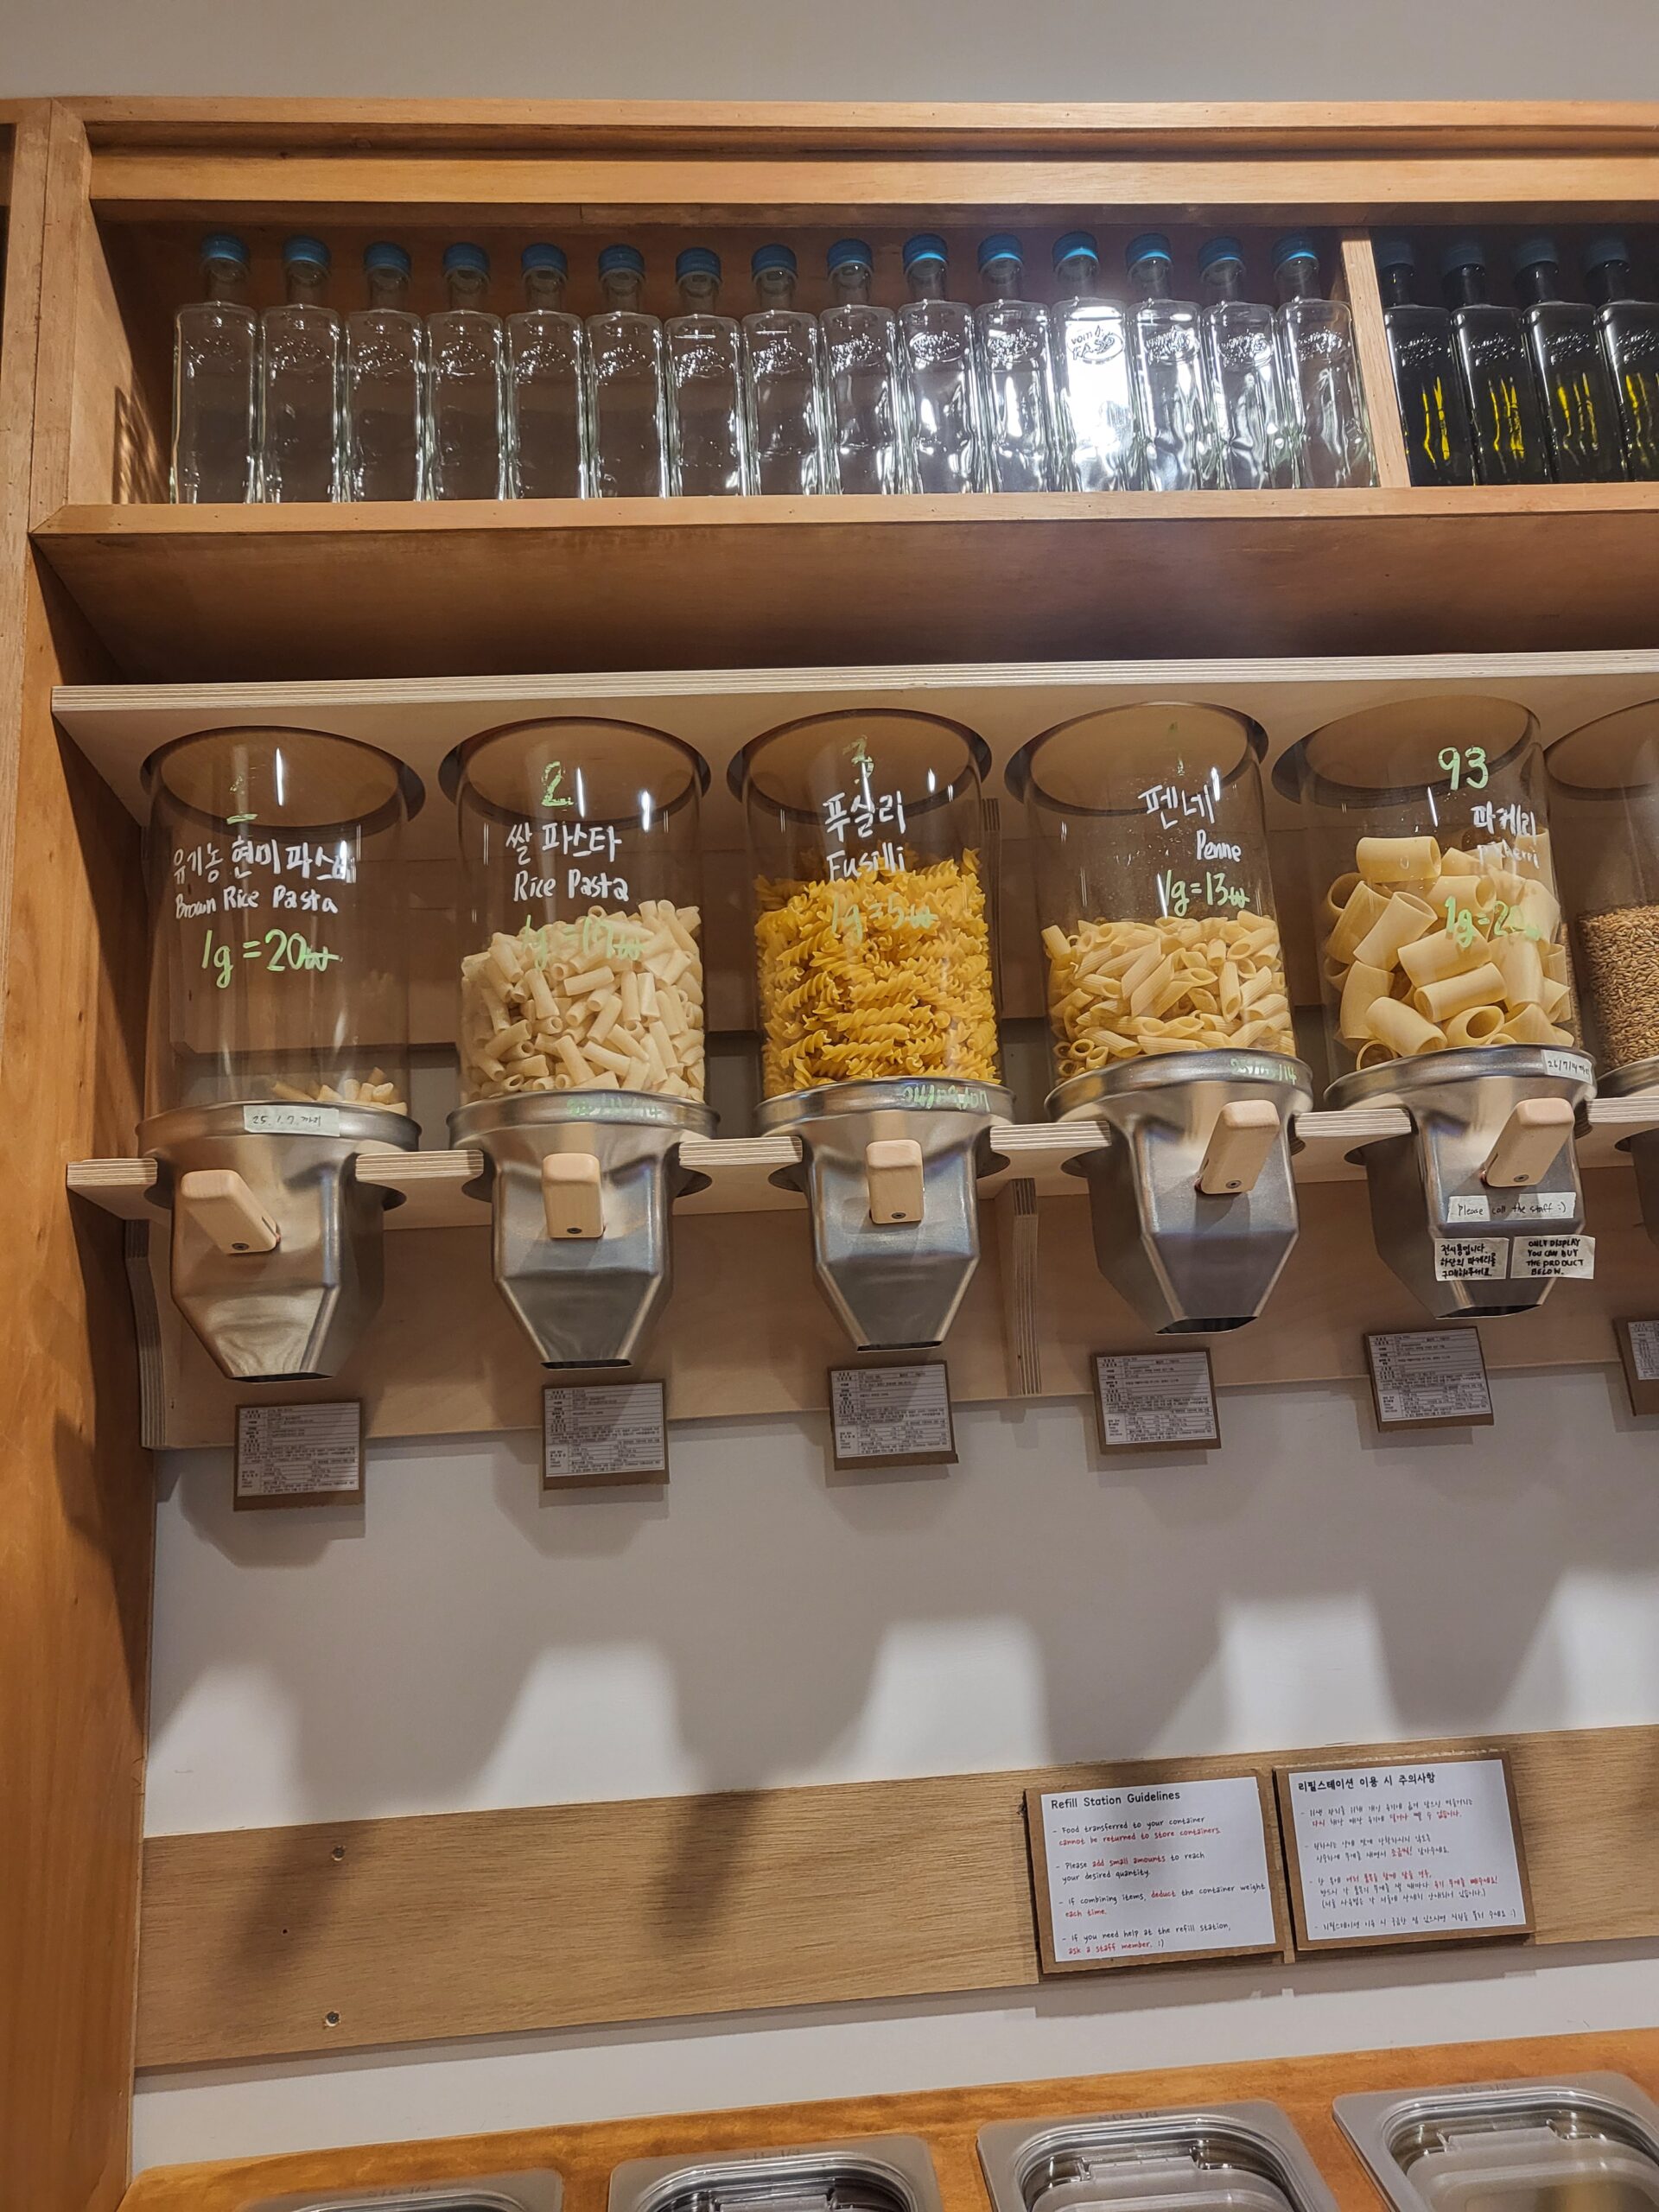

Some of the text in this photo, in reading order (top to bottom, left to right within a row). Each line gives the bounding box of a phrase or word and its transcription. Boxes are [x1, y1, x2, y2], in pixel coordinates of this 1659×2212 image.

[1438, 747, 1489, 791] 93
[541, 761, 574, 806] 2
[1138, 785, 1215, 830] 펜네
[505, 823, 622, 865] 쌀 파스타
[1197, 830, 1241, 861] Penne
[174, 842, 223, 884] 유기농
[232, 835, 281, 879] 현미
[826, 842, 906, 880] Fusilli
[514, 868, 629, 901] Rice Pasta
[175, 885, 338, 918] Brown Rice Pasta
[1458, 1204, 1484, 1217] Please
[1491, 1205, 1506, 1214] call
[1512, 1203, 1526, 1212] the
[1529, 1202, 1553, 1214] staff
[1549, 1238, 1580, 1248] DISPLAY
[1561, 1249, 1579, 1257] BUY
[1542, 1259, 1584, 1268] PRODUCT
[1298, 1772, 1435, 1792] 리필스테이션 이용 시 주의사항
[1051, 1790, 1180, 1809] Refill Station Guidelines
[1062, 1826, 1079, 1834] Food
[1084, 1822, 1128, 1833] transferred
[1147, 1820, 1164, 1829] your
[1169, 1816, 1205, 1826] container
[1103, 1834, 1135, 1842] returned
[1154, 1830, 1174, 1839] store
[1109, 1858, 1128, 1866] small
[1133, 1855, 1166, 1864] amounts
[1062, 1869, 1151, 1885] your desired quantity.
[1080, 1895, 1117, 1905] combining
[1122, 1892, 1147, 1902] items,
[1151, 1890, 1176, 1898] deduct
[1199, 1885, 1235, 1894] container
[1240, 1883, 1265, 1892] weight
[1071, 1934, 1077, 1942] If
[1084, 1934, 1097, 1943] you
[1124, 1929, 1138, 1939] help
[1176, 1924, 1195, 1933] refill
[1200, 1923, 1230, 1932] station,
[1096, 1943, 1116, 1952] staff
[1122, 1942, 1152, 1950] member.
